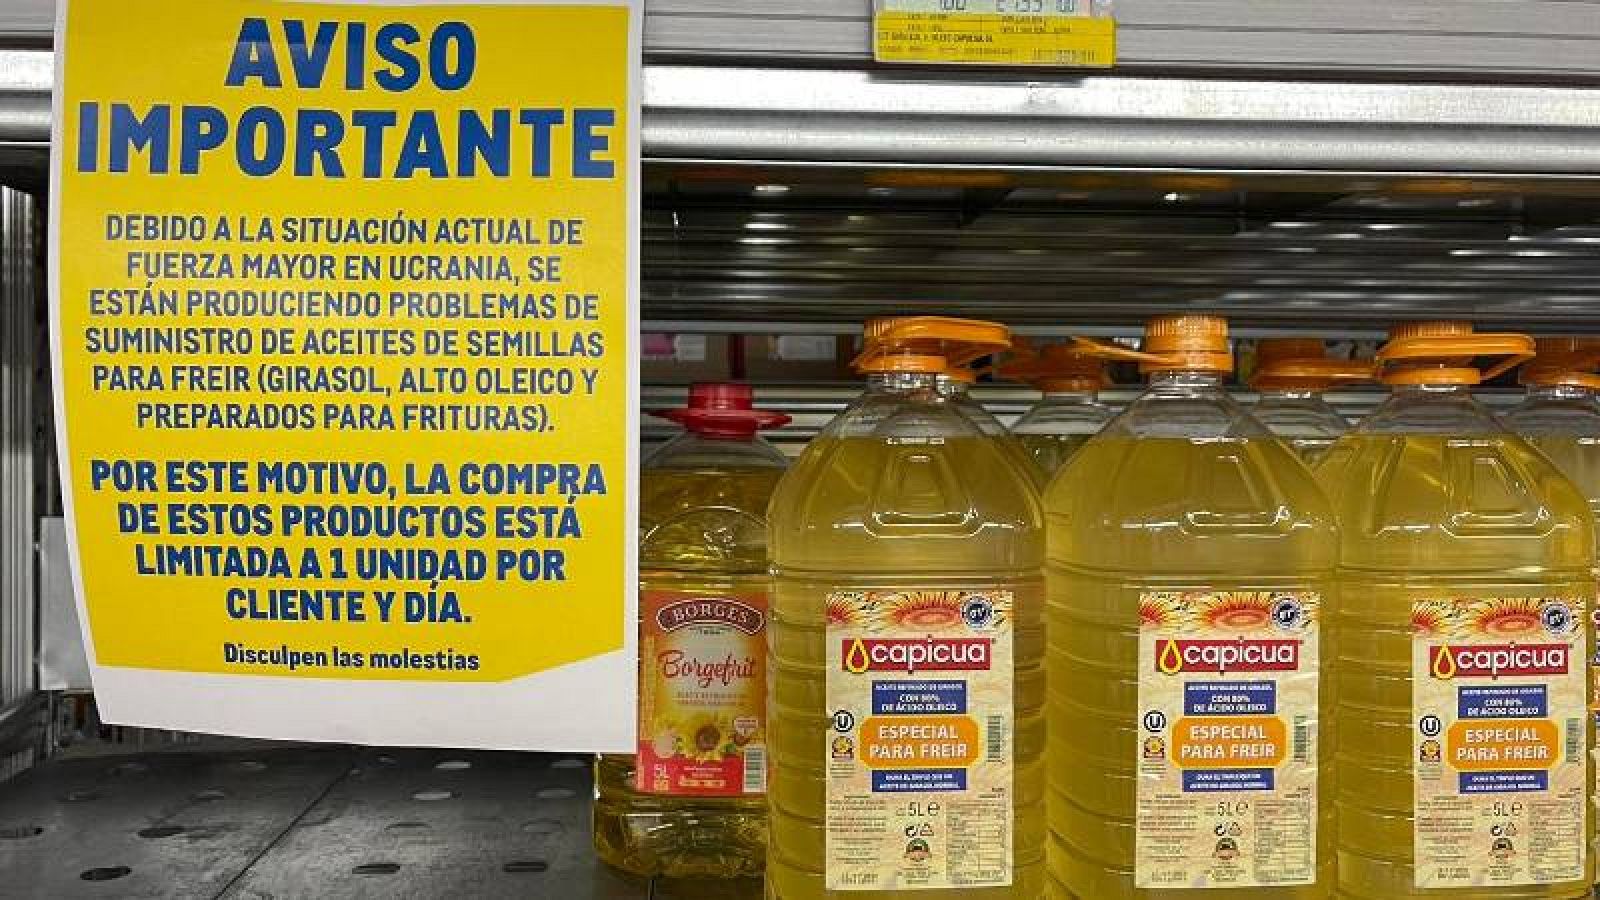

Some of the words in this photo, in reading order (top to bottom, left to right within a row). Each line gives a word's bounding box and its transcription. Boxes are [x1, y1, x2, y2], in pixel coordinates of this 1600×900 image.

[226, 17, 477, 92] AVISO
[78, 102, 615, 178] IMPORTANTE
[106, 215, 207, 241] DEBIDO
[214, 216, 231, 241] A
[240, 216, 274, 242] LA
[282, 210, 426, 244] SITUACIÓN
[434, 218, 539, 244] ACTUAL
[548, 219, 582, 245] DE
[127, 252, 234, 279] FUERZA
[241, 253, 335, 280] MAYOR
[344, 254, 381, 280] EN
[389, 254, 521, 286] UCRANIA,
[527, 256, 561, 282] SE
[89, 281, 178, 317] ESTÁN
[187, 291, 381, 318] PRODUCIENDO
[389, 292, 556, 320] PROBLEMAS
[565, 294, 598, 320] DE
[86, 327, 253, 354] SUMINISTRO
[261, 328, 295, 354] DE
[302, 329, 418, 355] ACEITES
[425, 330, 457, 356] DE
[466, 330, 604, 357] SEMILLAS
[93, 365, 165, 391] PARA
[172, 365, 249, 392] FREIR
[257, 365, 392, 397] (GIRASOL,
[399, 367, 469, 394] ALTO
[475, 368, 573, 395] OLEICO
[580, 368, 597, 395] Y
[137, 403, 315, 429] PREPARADOS
[323, 404, 394, 430] PARA
[402, 405, 554, 433] FRITURAS).
[91, 459, 158, 492] POR
[167, 461, 249, 493] ESTE
[257, 462, 398, 500] MOTIVO,
[406, 463, 451, 495] LA
[459, 463, 607, 495] COMPRA
[118, 503, 161, 535] DE
[168, 504, 273, 536] ESTOS
[282, 504, 486, 538] PRODUCTOS
[496, 493, 581, 538] ESTÁ
[136, 545, 292, 578] LIMITADA
[298, 546, 323, 579] A
[329, 547, 348, 579] 1
[356, 548, 486, 581] UNIDAD
[497, 549, 565, 581] POR
[227, 587, 365, 622] CLIENTE
[374, 590, 396, 622] Y
[404, 580, 472, 624] DÍA.
[671, 603, 749, 623] BORGES
[224, 642, 327, 672] Disculpen
[332, 645, 363, 669] las
[370, 648, 479, 672] molestias
[872, 637, 985, 671] capicua
[1183, 637, 1293, 673] capicua
[1457, 642, 1565, 679] capicua
[879, 725, 959, 739] ESPECIAL
[1190, 725, 1267, 739] ESPECIAL
[1466, 727, 1541, 743] ESPECIAL
[869, 745, 915, 759] PARA
[921, 743, 967, 758] FREIR
[1181, 744, 1225, 759] PARA
[1230, 743, 1275, 758] FREIR
[1457, 747, 1499, 761] PARA
[1504, 745, 1549, 760] FREIR
